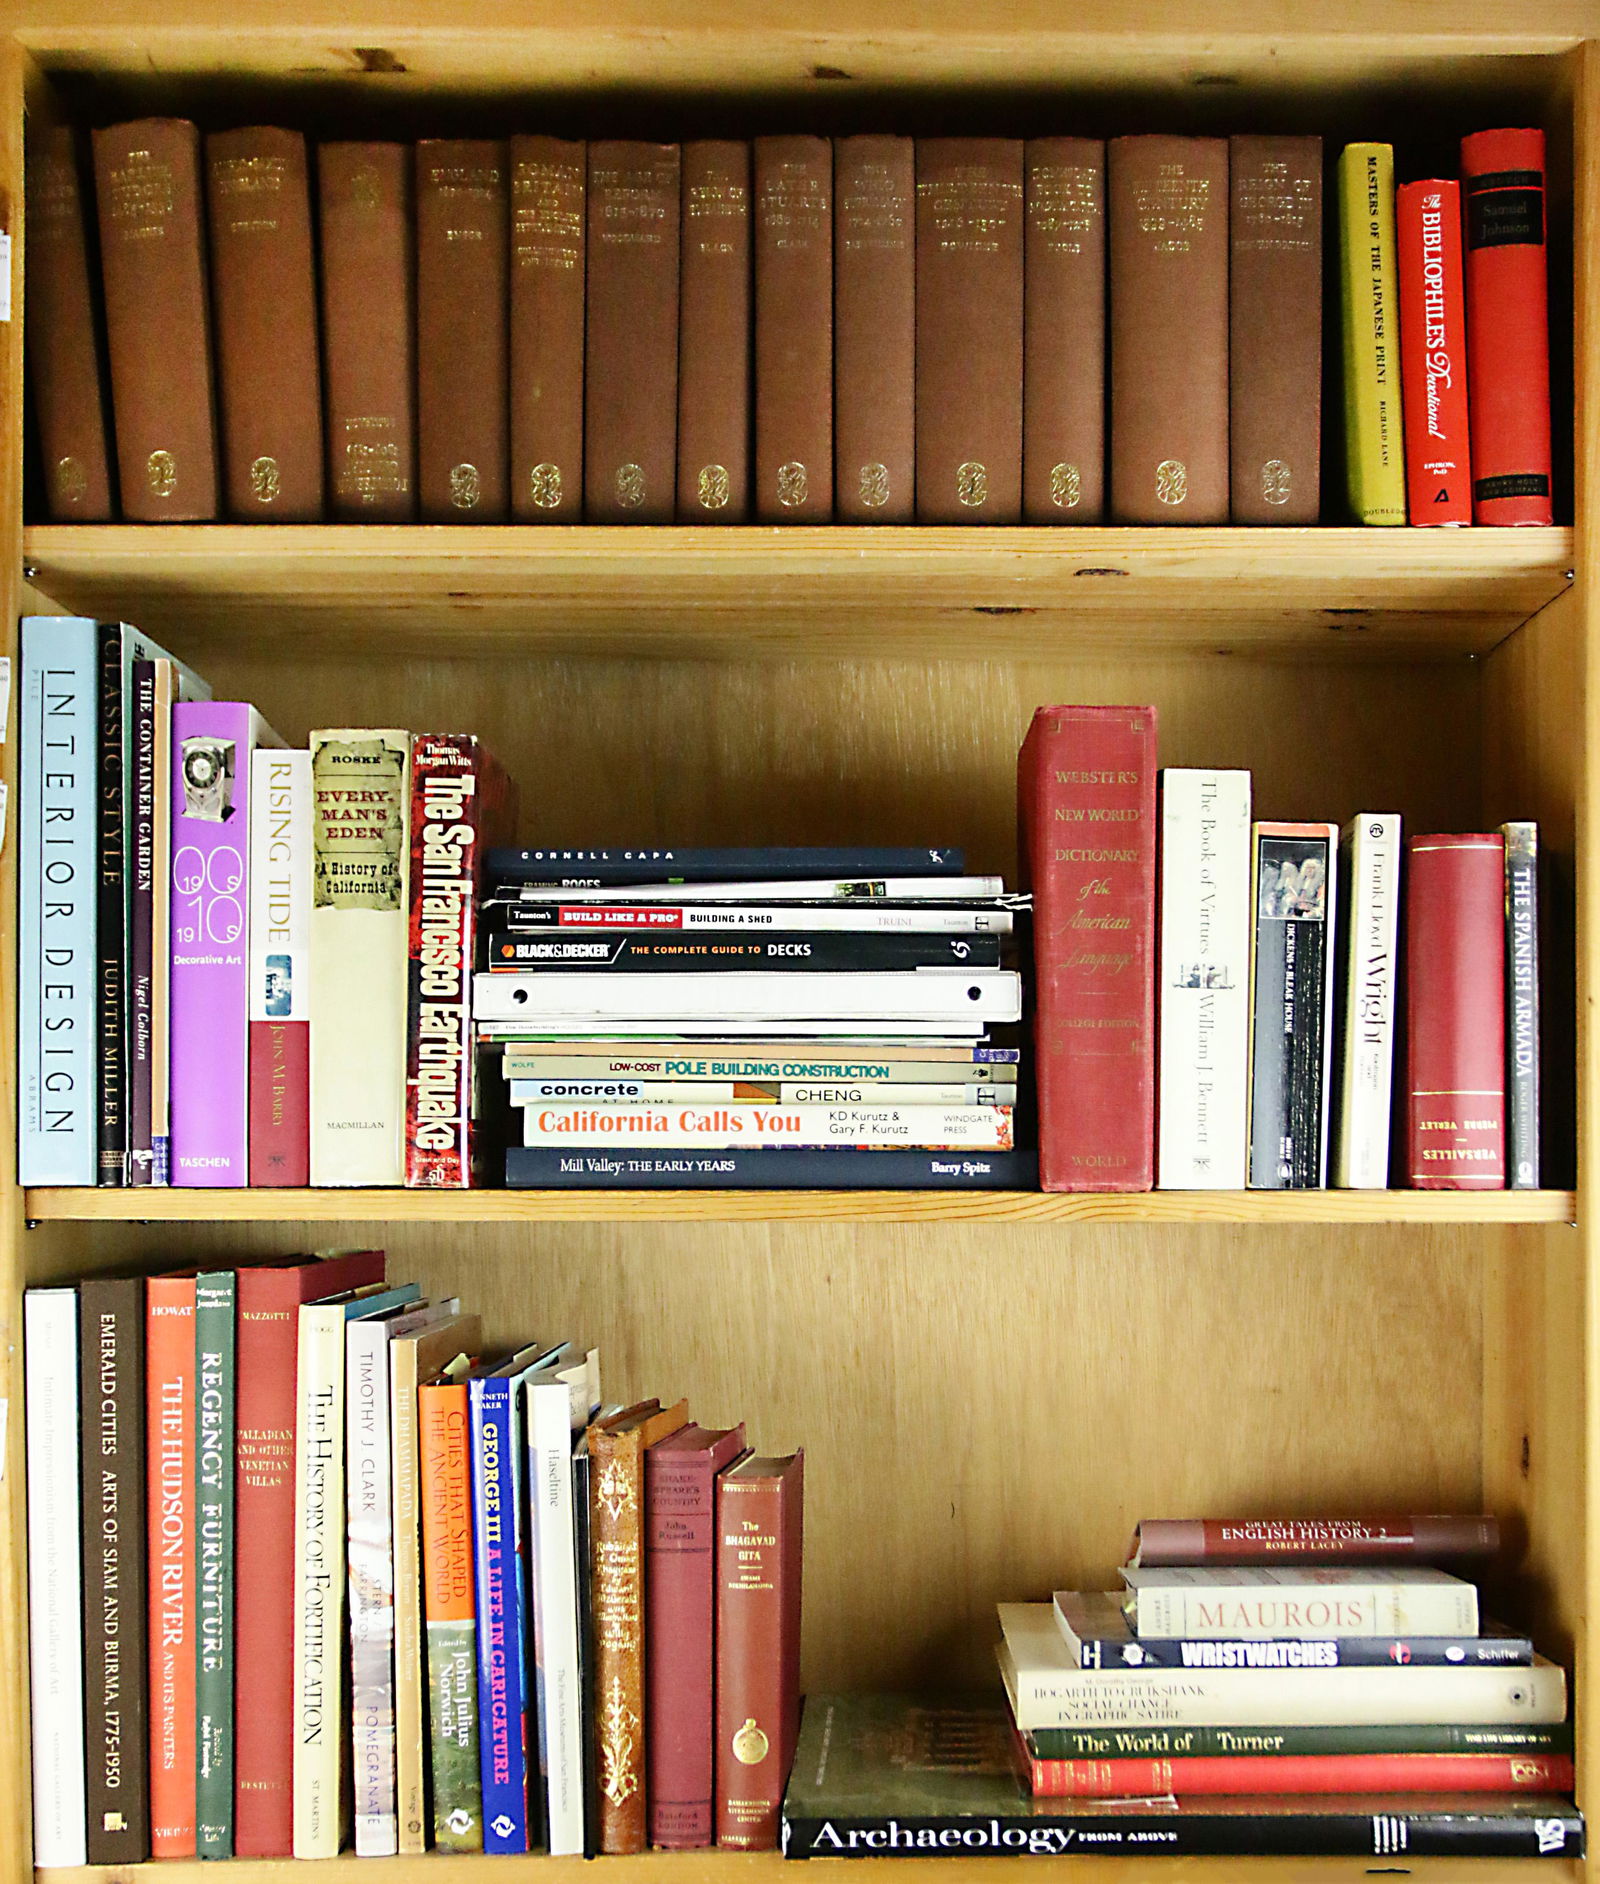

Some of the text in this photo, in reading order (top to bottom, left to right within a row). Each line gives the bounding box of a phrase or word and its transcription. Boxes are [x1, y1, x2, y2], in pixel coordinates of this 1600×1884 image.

[1483, 201, 1527, 216] Samuel
[1480, 222, 1529, 240] Johnson
[1367, 156, 1386, 385] MASTERS OF THE JAPANESE PRINT
[1422, 194, 1452, 440] The BIBLIOPHILES Devotional
[139, 678, 153, 712] THE
[138, 719, 153, 815] CONTAINER
[331, 756, 381, 764] ROSKE
[1056, 771, 1138, 784] WEBSTER'S
[317, 791, 394, 803] EVERY-
[322, 809, 388, 821] MAN'S
[1055, 809, 1139, 822] NEW WORLD
[327, 828, 385, 839] EDEN
[138, 822, 151, 890] GARDEN
[268, 763, 292, 942] RISING TIDE
[521, 851, 674, 860] CORNELL CAPA
[1055, 850, 1138, 862] DICTIONARY
[320, 862, 394, 878] A History of
[1200, 778, 1217, 954] The Book of Virtues
[326, 880, 387, 894] California
[1076, 878, 1112, 900] of the
[45, 670, 75, 1132] INTERIOR DESIGN
[513, 911, 912, 926] Taunton's BUILD LIKE A BUILDING A SHED TRUINI
[1052, 909, 1131, 935] American
[174, 955, 242, 965] Decorative Art
[515, 944, 812, 958] BLACK&DECKER THE COMPLETE GUIDE TO DECKS
[407, 774, 476, 1150] The San Francisco Earthquake
[1514, 869, 1533, 1077] THE SPANISH ARMADA
[135, 975, 150, 1008] Nigel
[1360, 953, 1387, 1043] Wright
[103, 959, 118, 1126] JUDITH MILLER
[136, 1013, 149, 1061] Colborn
[609, 1063, 661, 1072] LOW-COST
[665, 1062, 707, 1075] POLE
[711, 1063, 779, 1076] BUILDING
[782, 1064, 890, 1078] CONSTRUCTION
[540, 1083, 862, 1101] concrete CHENG
[327, 1121, 385, 1130] MACMILLAN
[538, 1111, 801, 1132] California Calls You
[829, 1112, 900, 1121] KD Kurutz &
[944, 1115, 993, 1123] WINDGATE
[829, 1124, 909, 1137] Gary F. Kurutz
[179, 1157, 230, 1168] TASCHEN
[1072, 1156, 1127, 1167] WORLD
[1422, 1149, 1497, 1160] VERSAILLES
[560, 1159, 990, 1177] Mill Valley: THE EARLY YEARS Barry Spitz
[152, 1307, 193, 1316] HOWAT
[360, 1352, 374, 1432] TIMOTHY
[361, 1459, 376, 1511] CLARK
[549, 1449, 562, 1508] Haseltine
[161, 1376, 184, 1647] THE HUDSON RIVER
[202, 1352, 223, 1672] REGENCY FURNITURE
[430, 1410, 450, 1603] THE ANCIENT WORLD
[447, 1411, 467, 1598] CITIES THAT SHAPED
[742, 1521, 759, 1531] The
[1222, 1528, 1386, 1540] ENGLISH HISTORY 2
[725, 1536, 776, 1546] BHAGAVAD
[1265, 1541, 1344, 1550] ROBERT LACEY
[101, 1314, 120, 1788] EMERALD CITIES ARTS OF SIAM AND BURMA, 1775-1950
[738, 1551, 761, 1561] GITA
[482, 1423, 509, 1785] GEORGE III A LIFE IN CARICATURE
[1198, 1601, 1362, 1627] MAUROIS
[1181, 1641, 1338, 1667] WRISTWATCHES
[439, 1664, 457, 1737] Norwich
[452, 1652, 473, 1747] John Julius
[1034, 1685, 1205, 1699] HOGARTH TO CRUIKSHANK
[1073, 1733, 1284, 1752] The World of Turner
[365, 1706, 380, 1825] POMEGRANATE
[810, 1820, 1178, 1854] Archaeology FROM ABOVE
